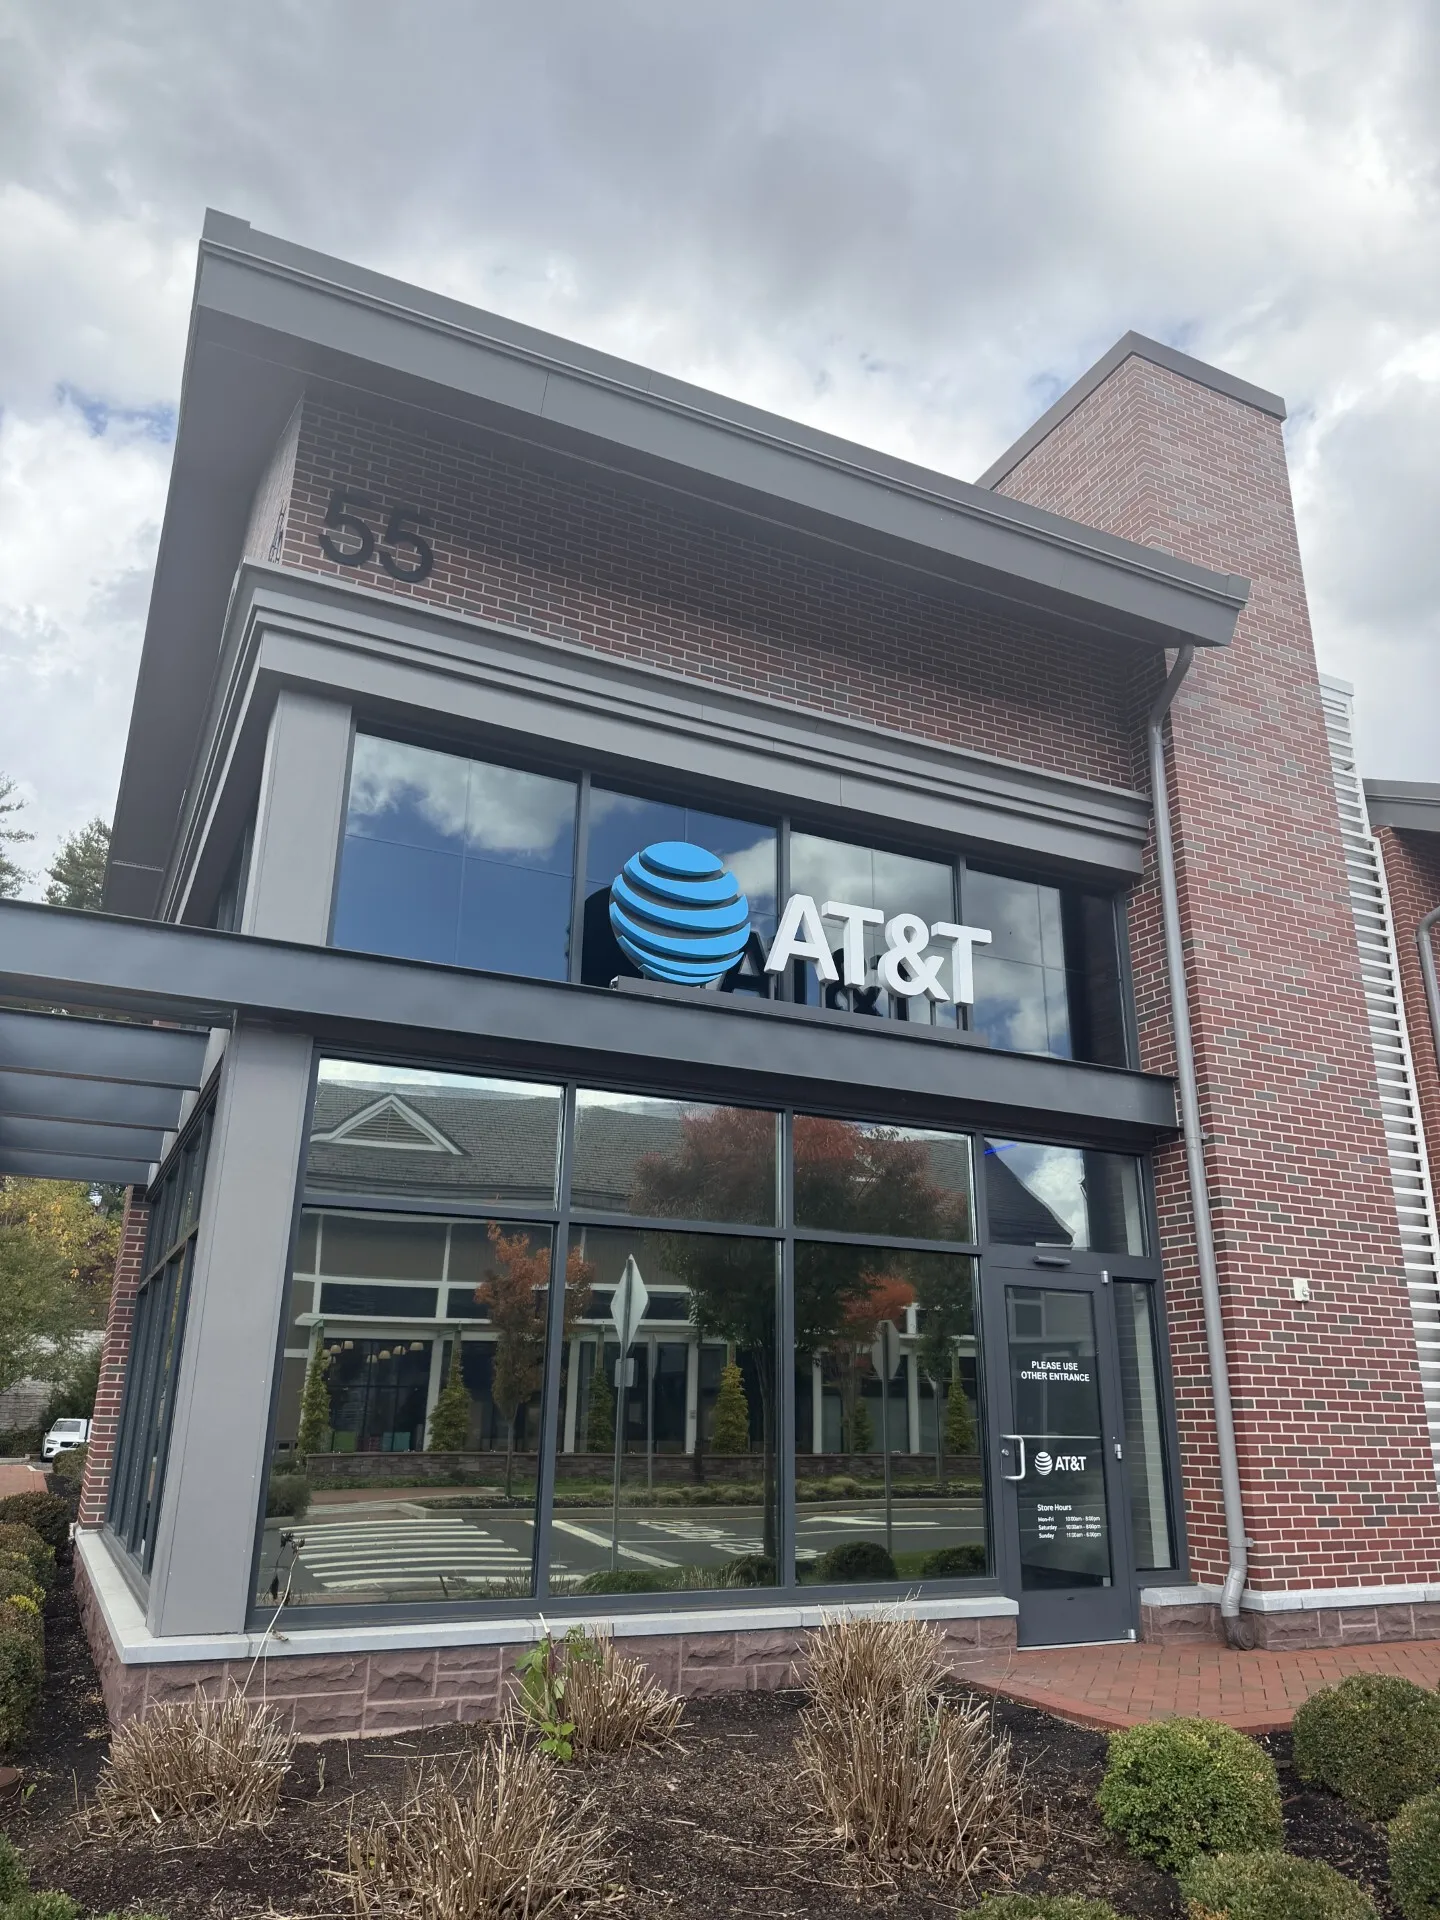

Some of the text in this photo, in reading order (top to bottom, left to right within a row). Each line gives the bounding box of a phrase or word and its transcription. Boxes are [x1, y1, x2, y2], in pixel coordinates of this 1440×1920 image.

[318, 488, 434, 583] 55
[764, 893, 992, 1006] AT&T
[1031, 1361, 1078, 1371] PLEASE USE
[1021, 1371, 1090, 1382] OTHER ENTRANCE
[1055, 1456, 1087, 1471] AT&T
